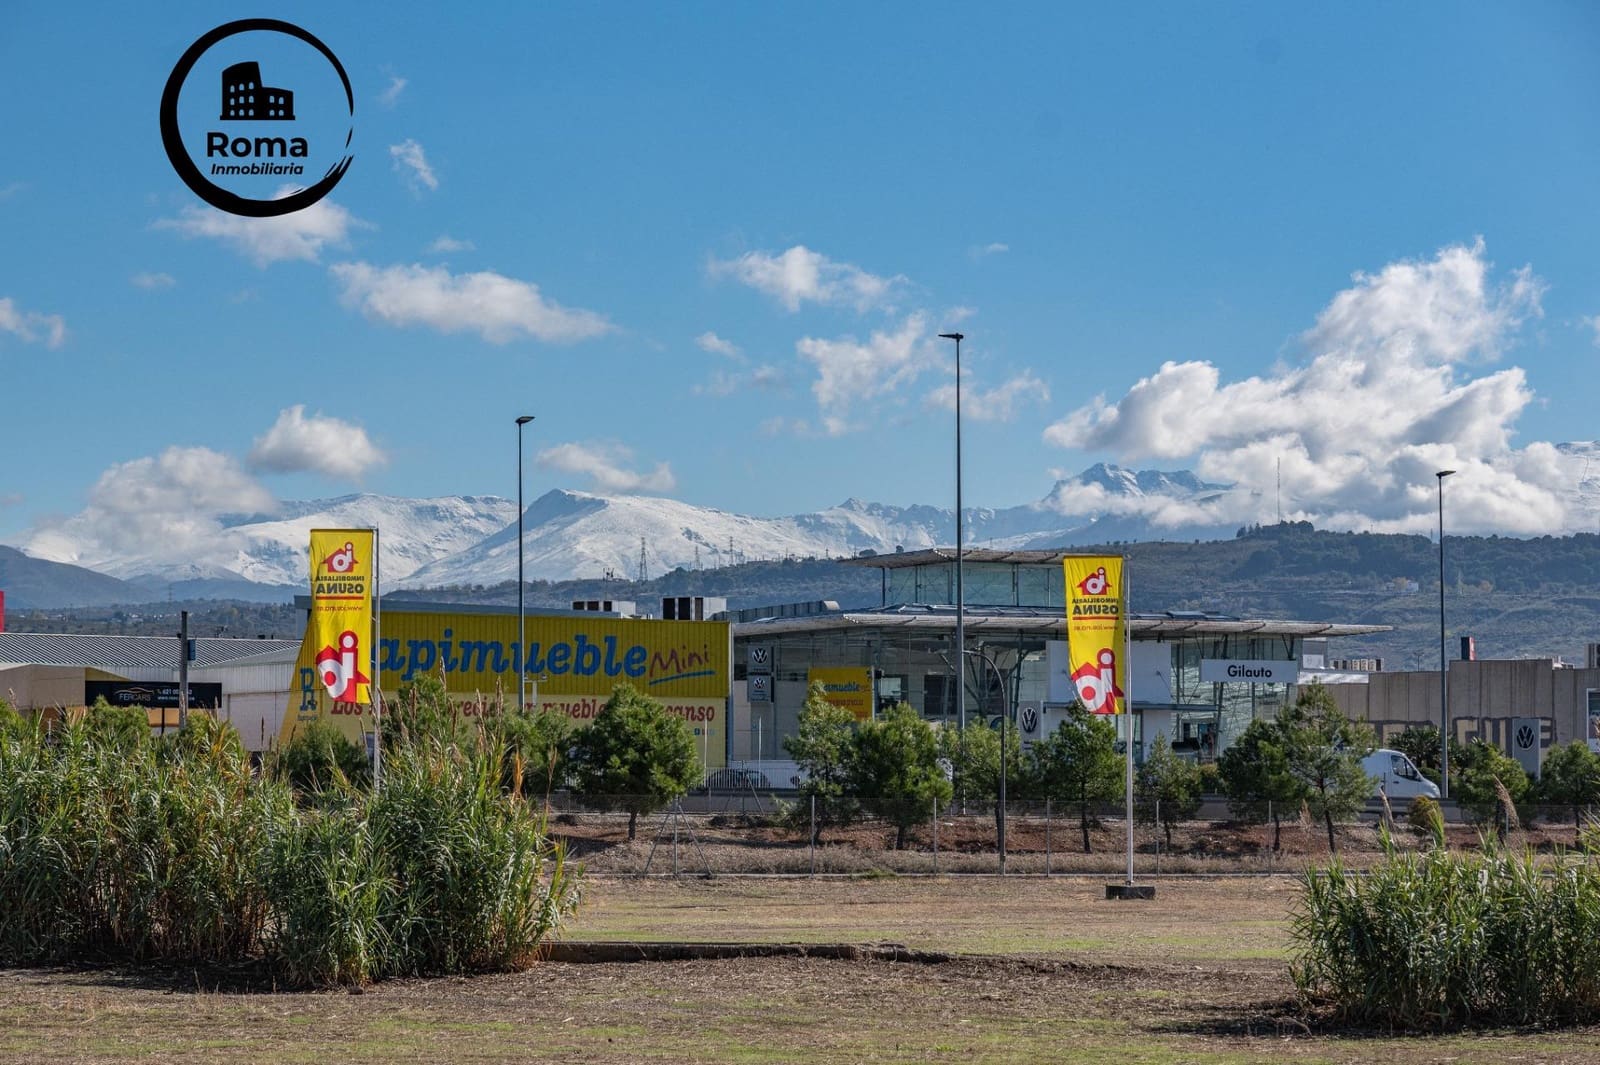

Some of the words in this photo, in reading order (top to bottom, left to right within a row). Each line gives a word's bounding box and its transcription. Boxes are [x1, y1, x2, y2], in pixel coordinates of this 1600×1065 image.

[370, 628, 648, 681] apimueble
[649, 644, 710, 678] Mini
[1227, 664, 1273, 678] Gilauto
